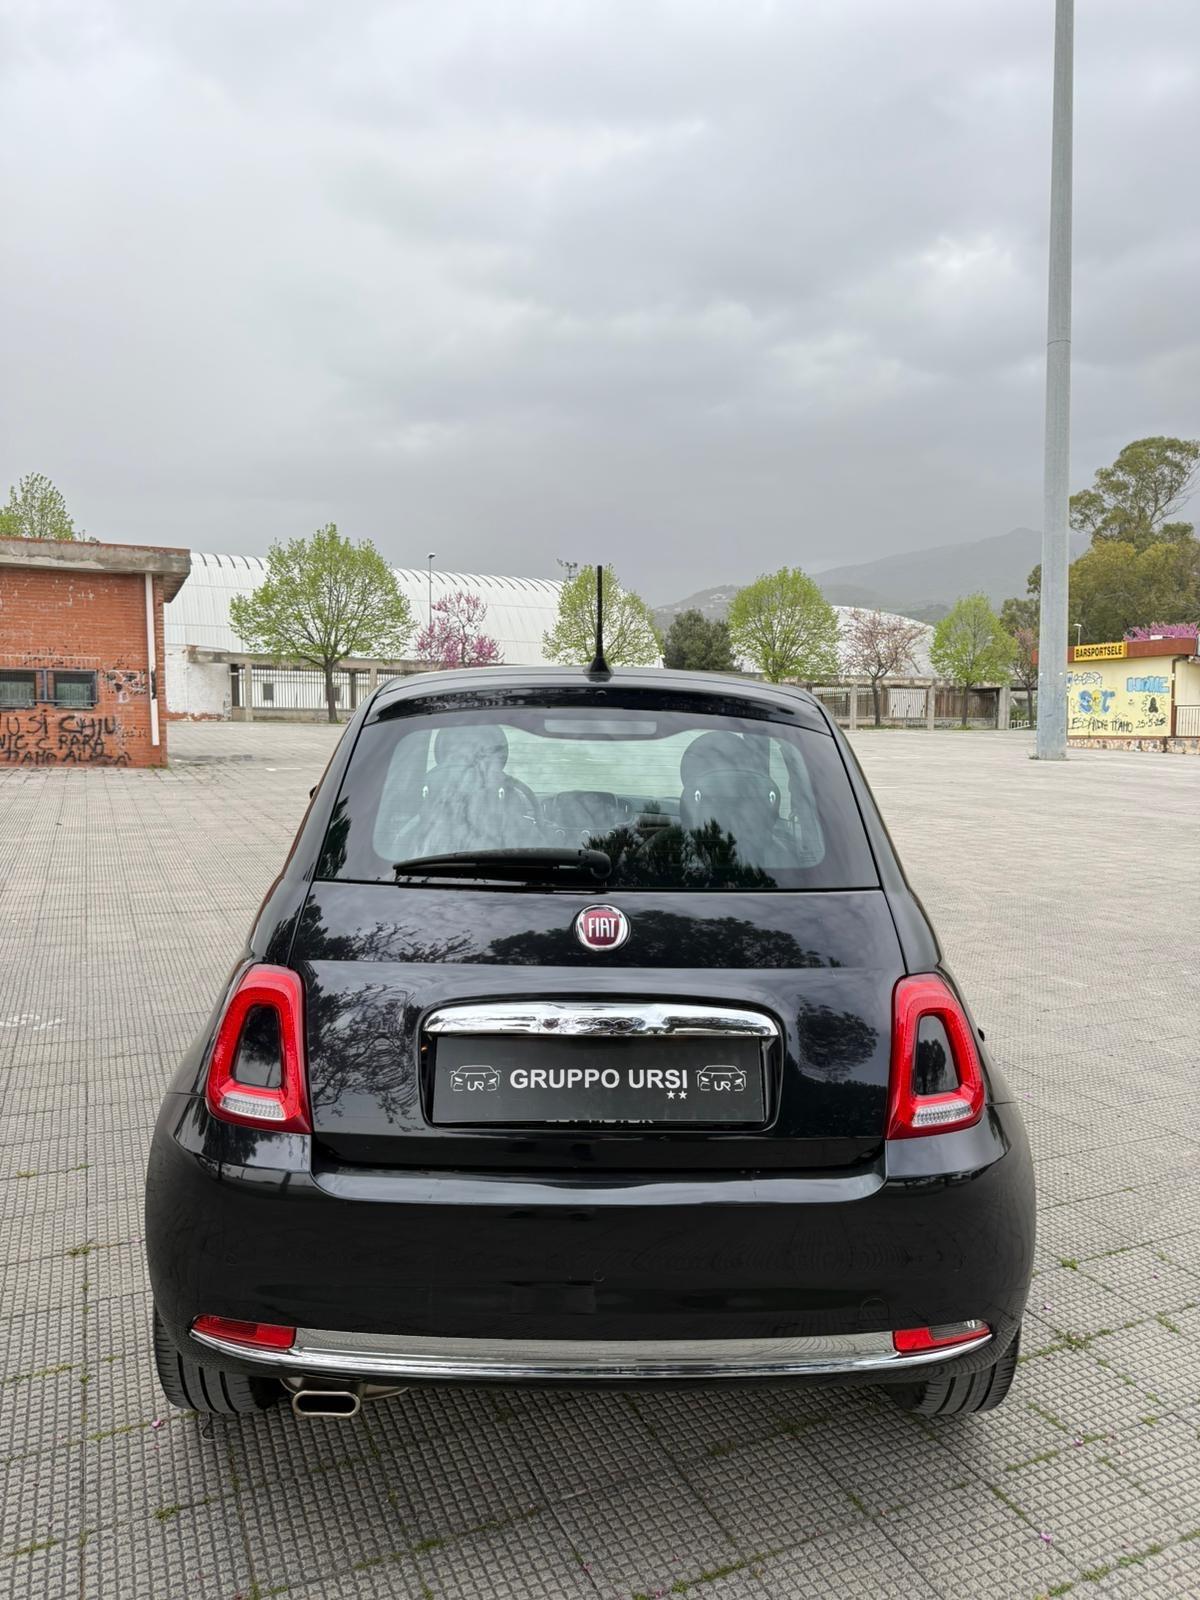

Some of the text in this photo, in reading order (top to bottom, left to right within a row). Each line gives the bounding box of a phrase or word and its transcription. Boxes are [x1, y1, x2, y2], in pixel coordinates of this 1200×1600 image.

[588, 917, 617, 938] FIAT
[509, 1068, 688, 1089] GRUPPO URSI
